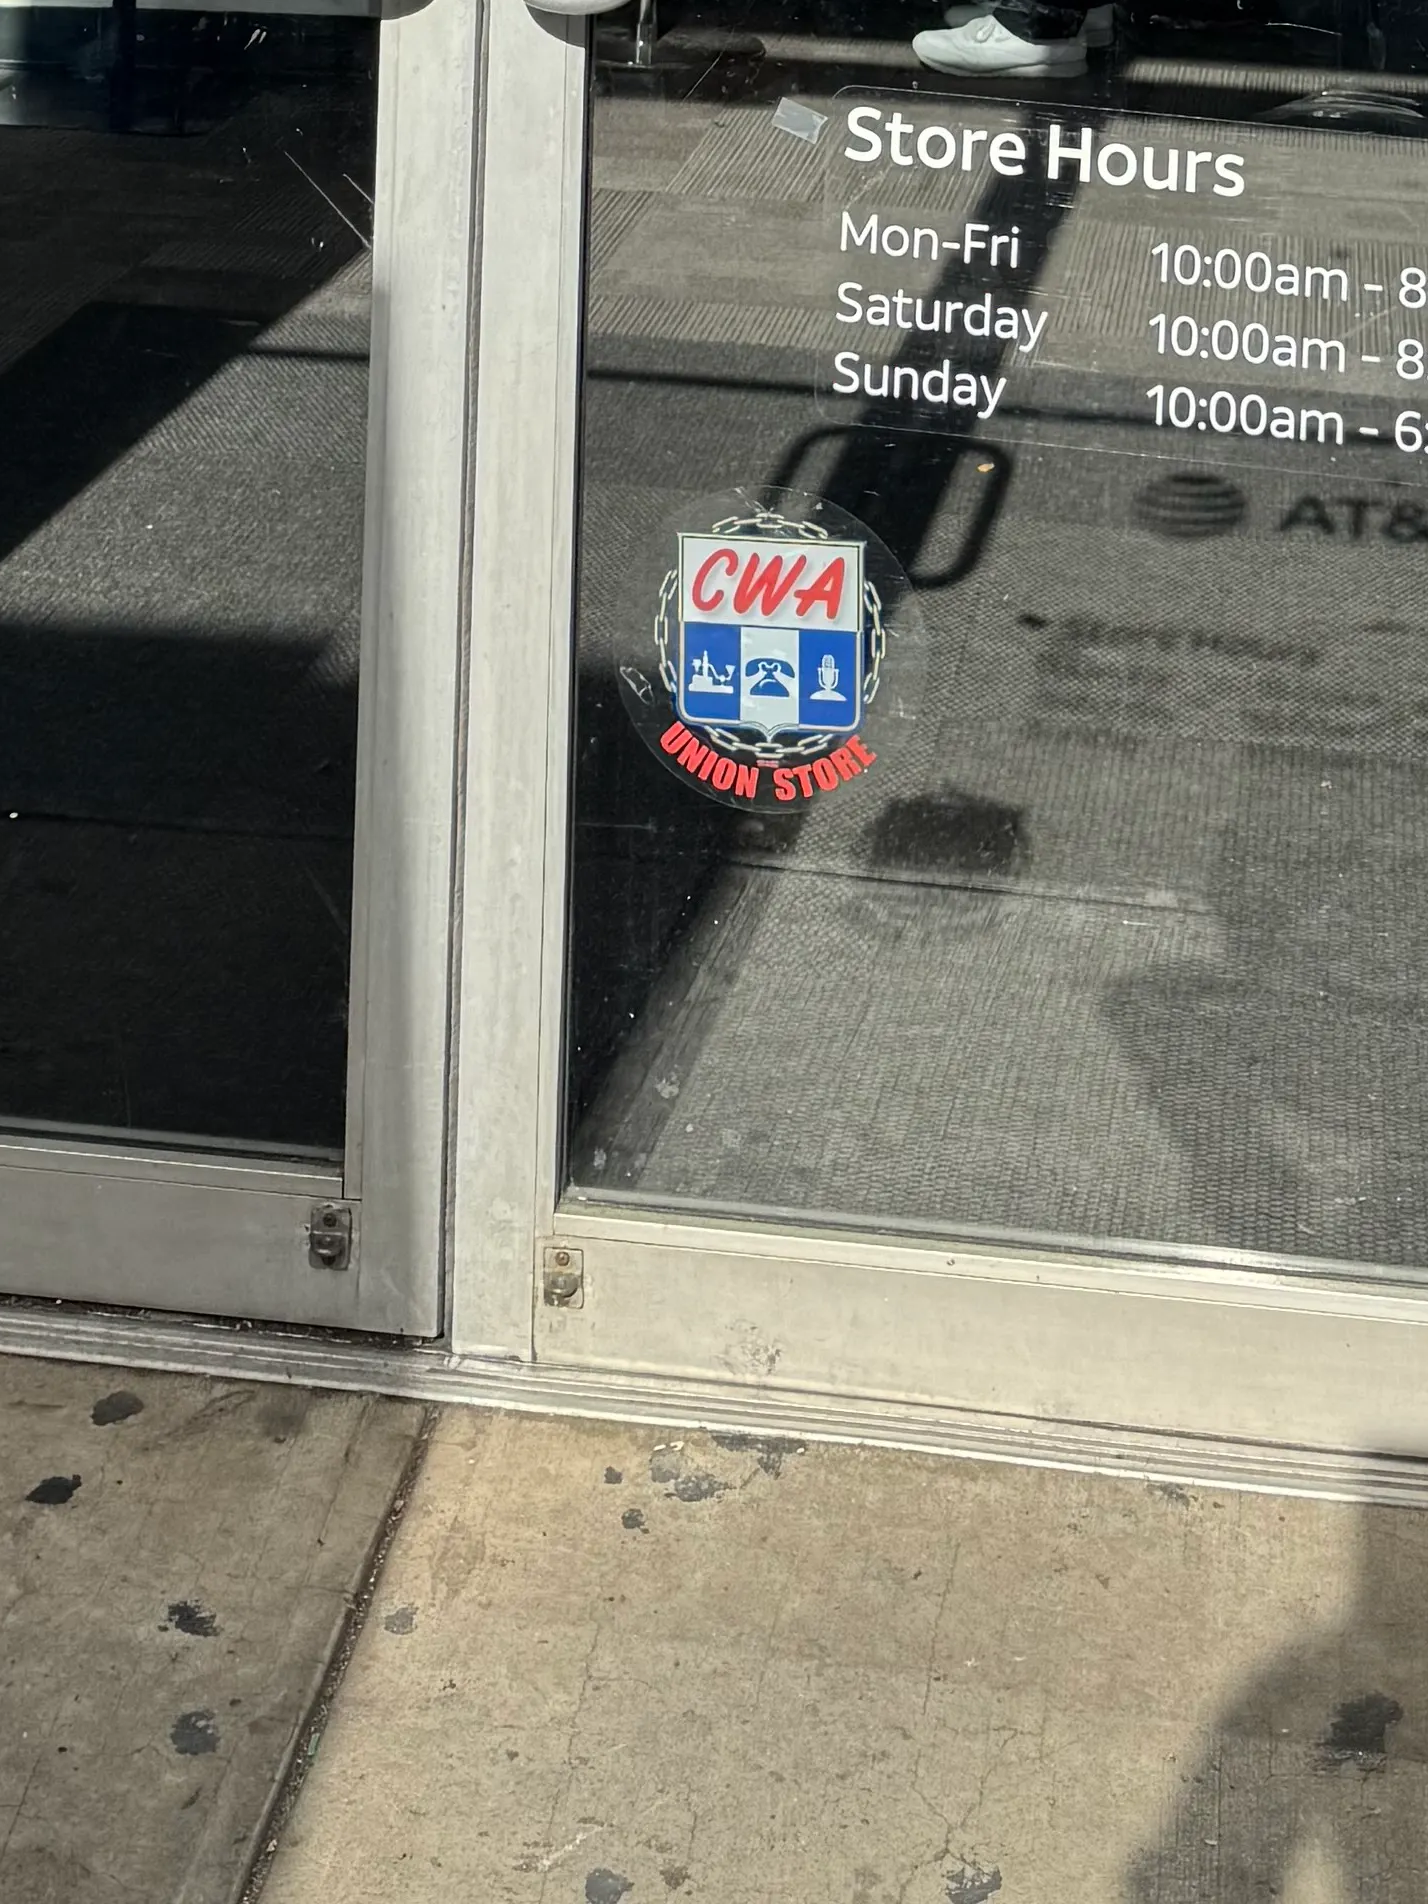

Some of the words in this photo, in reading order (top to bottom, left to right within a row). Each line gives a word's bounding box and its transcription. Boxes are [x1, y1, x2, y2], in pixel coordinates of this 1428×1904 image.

[844, 106, 1026, 177] Store
[1047, 123, 1246, 198] Hours
[839, 210, 1020, 270] Mon-Fri
[1151, 242, 1349, 302] 10:00am
[835, 281, 1049, 353] Saturday
[1148, 313, 1346, 374] 10:00am
[832, 351, 1007, 419] Sunday
[1146, 384, 1344, 445] 10:00am
[691, 547, 847, 620] CWA
[659, 721, 761, 800] UNION
[772, 734, 877, 802] STORE
